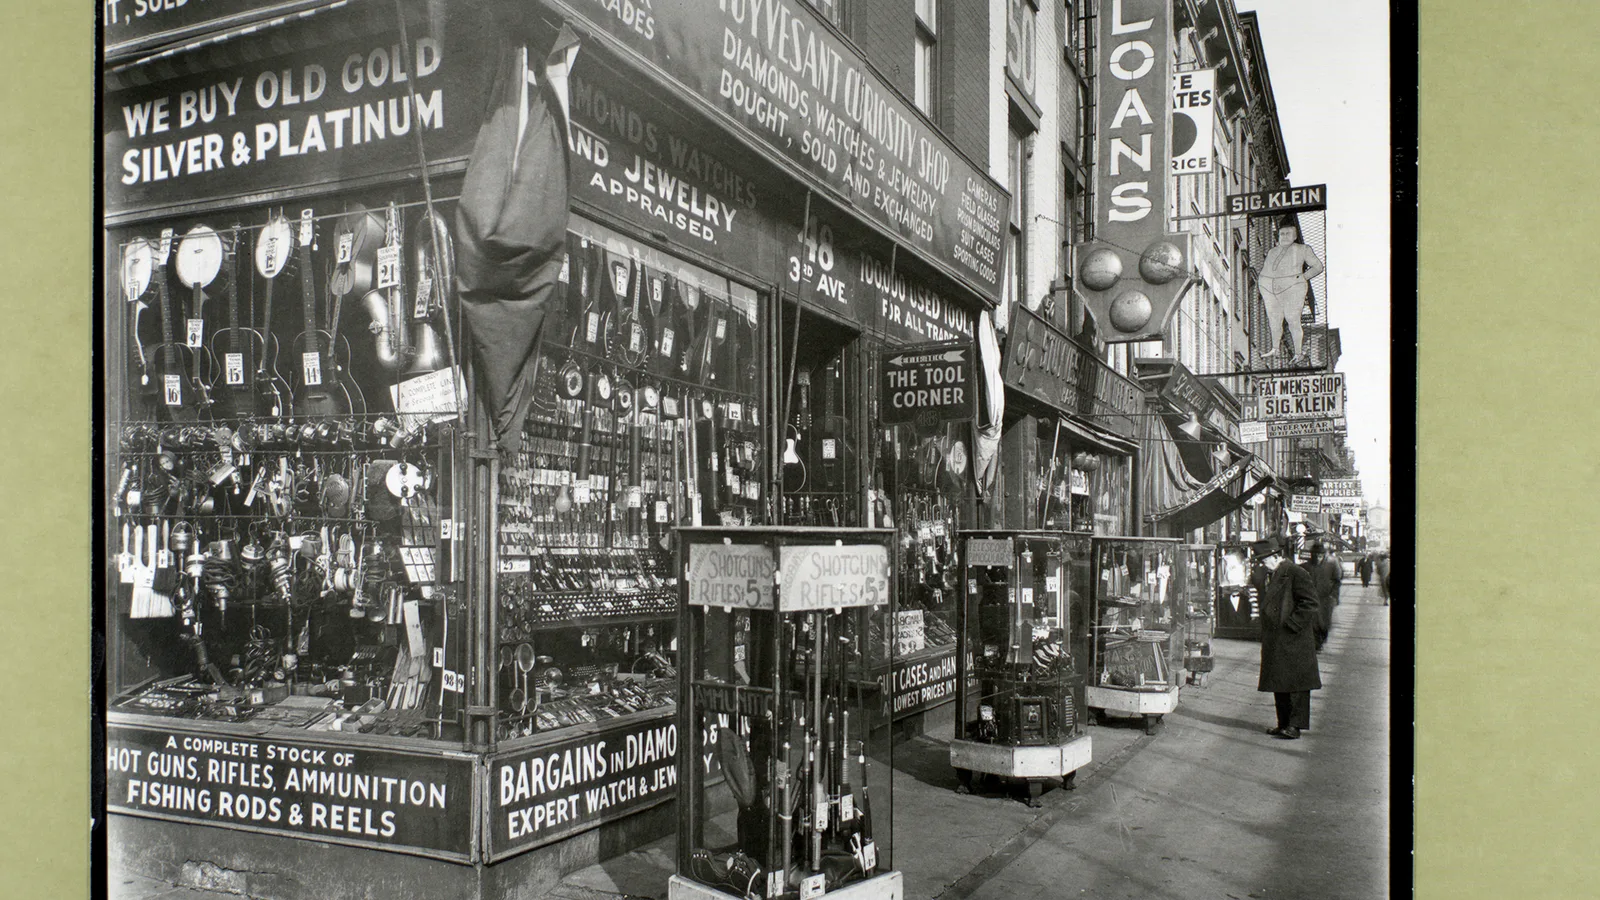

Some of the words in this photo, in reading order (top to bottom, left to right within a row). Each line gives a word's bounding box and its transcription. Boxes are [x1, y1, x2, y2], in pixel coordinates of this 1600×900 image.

[122, 98, 170, 138] WE
[180, 77, 243, 129] BUY
[255, 64, 327, 109] OLD
[342, 37, 442, 93] GOLD
[719, 0, 842, 103] YVESANT
[844, 68, 917, 167] CURIOSITY
[918, 137, 950, 195] SHOP
[1173, 90, 1212, 109] TES
[723, 27, 811, 126] DIAMONDS,
[816, 101, 875, 171] WATCHES
[878, 158, 886, 182] &
[888, 165, 937, 217] JEWELRY
[1109, 0, 1155, 223] LOANS
[121, 134, 225, 185] SILVER
[231, 131, 251, 166] &
[255, 90, 444, 161] PLATINUM
[569, 77, 663, 163] MONDS,
[669, 134, 757, 209] WATCHES
[720, 68, 792, 148] BOUGHT,
[801, 130, 837, 173] SOLD
[842, 162, 871, 199] AND
[874, 186, 934, 242] EXCHANGED
[590, 172, 718, 245] APPRAISED.
[624, 155, 737, 232] JEWELRY
[966, 176, 998, 212] CAMERAS
[1231, 194, 1266, 213] SIG.
[1268, 187, 1321, 208] KLEIN
[957, 207, 973, 229] PRISM
[973, 219, 1001, 251] BINOCULARS
[961, 191, 977, 215] FIELD
[976, 205, 1000, 233] GLASSES
[797, 214, 834, 271] 48
[960, 229, 975, 249] SUIT
[975, 241, 995, 265] CASES
[953, 244, 979, 272] SPORTING
[979, 262, 997, 285] GOODS
[816, 273, 848, 305] AVE.
[860, 252, 906, 302] 100,000
[910, 280, 940, 320] USED
[883, 298, 901, 324] FOR
[905, 311, 924, 334] ALL
[887, 369, 918, 388] THE
[924, 365, 965, 386] TOOL
[1260, 380, 1277, 396] FAT
[1280, 379, 1310, 395] MEN'S
[1312, 377, 1341, 393] SHOP
[893, 387, 964, 408] CORNER
[1265, 398, 1294, 415] SIG.
[1295, 396, 1336, 413] KLEIN
[1213, 464, 1241, 488] SHOP
[1322, 481, 1354, 489] ARTIST
[708, 550, 772, 580] SHOTGUNS
[810, 552, 887, 580] SHOTGUNS
[700, 578, 741, 605] RIFLES
[801, 581, 858, 607] RIFLES
[900, 662, 928, 690] CASES
[929, 665, 942, 682] AND
[941, 656, 957, 678] HAN
[894, 690, 920, 713] LOWEST
[921, 682, 945, 703] PRICES
[946, 680, 953, 695] IN
[166, 735, 178, 749] A
[183, 737, 258, 758] COMPLETE
[267, 745, 326, 766] STOCK
[333, 753, 355, 767] OF
[147, 752, 201, 782] GUNS,
[207, 758, 277, 792] RIFLES,
[285, 769, 447, 809] AMMUNITION
[500, 741, 607, 807] BARGAINS
[610, 751, 624, 774] IN
[128, 779, 211, 813] FISHING
[218, 791, 282, 821] RODS
[289, 804, 303, 825] &
[311, 804, 396, 837] REELS
[508, 794, 580, 840] EXPERT
[585, 776, 636, 814] WATCH
[639, 776, 648, 795] &
